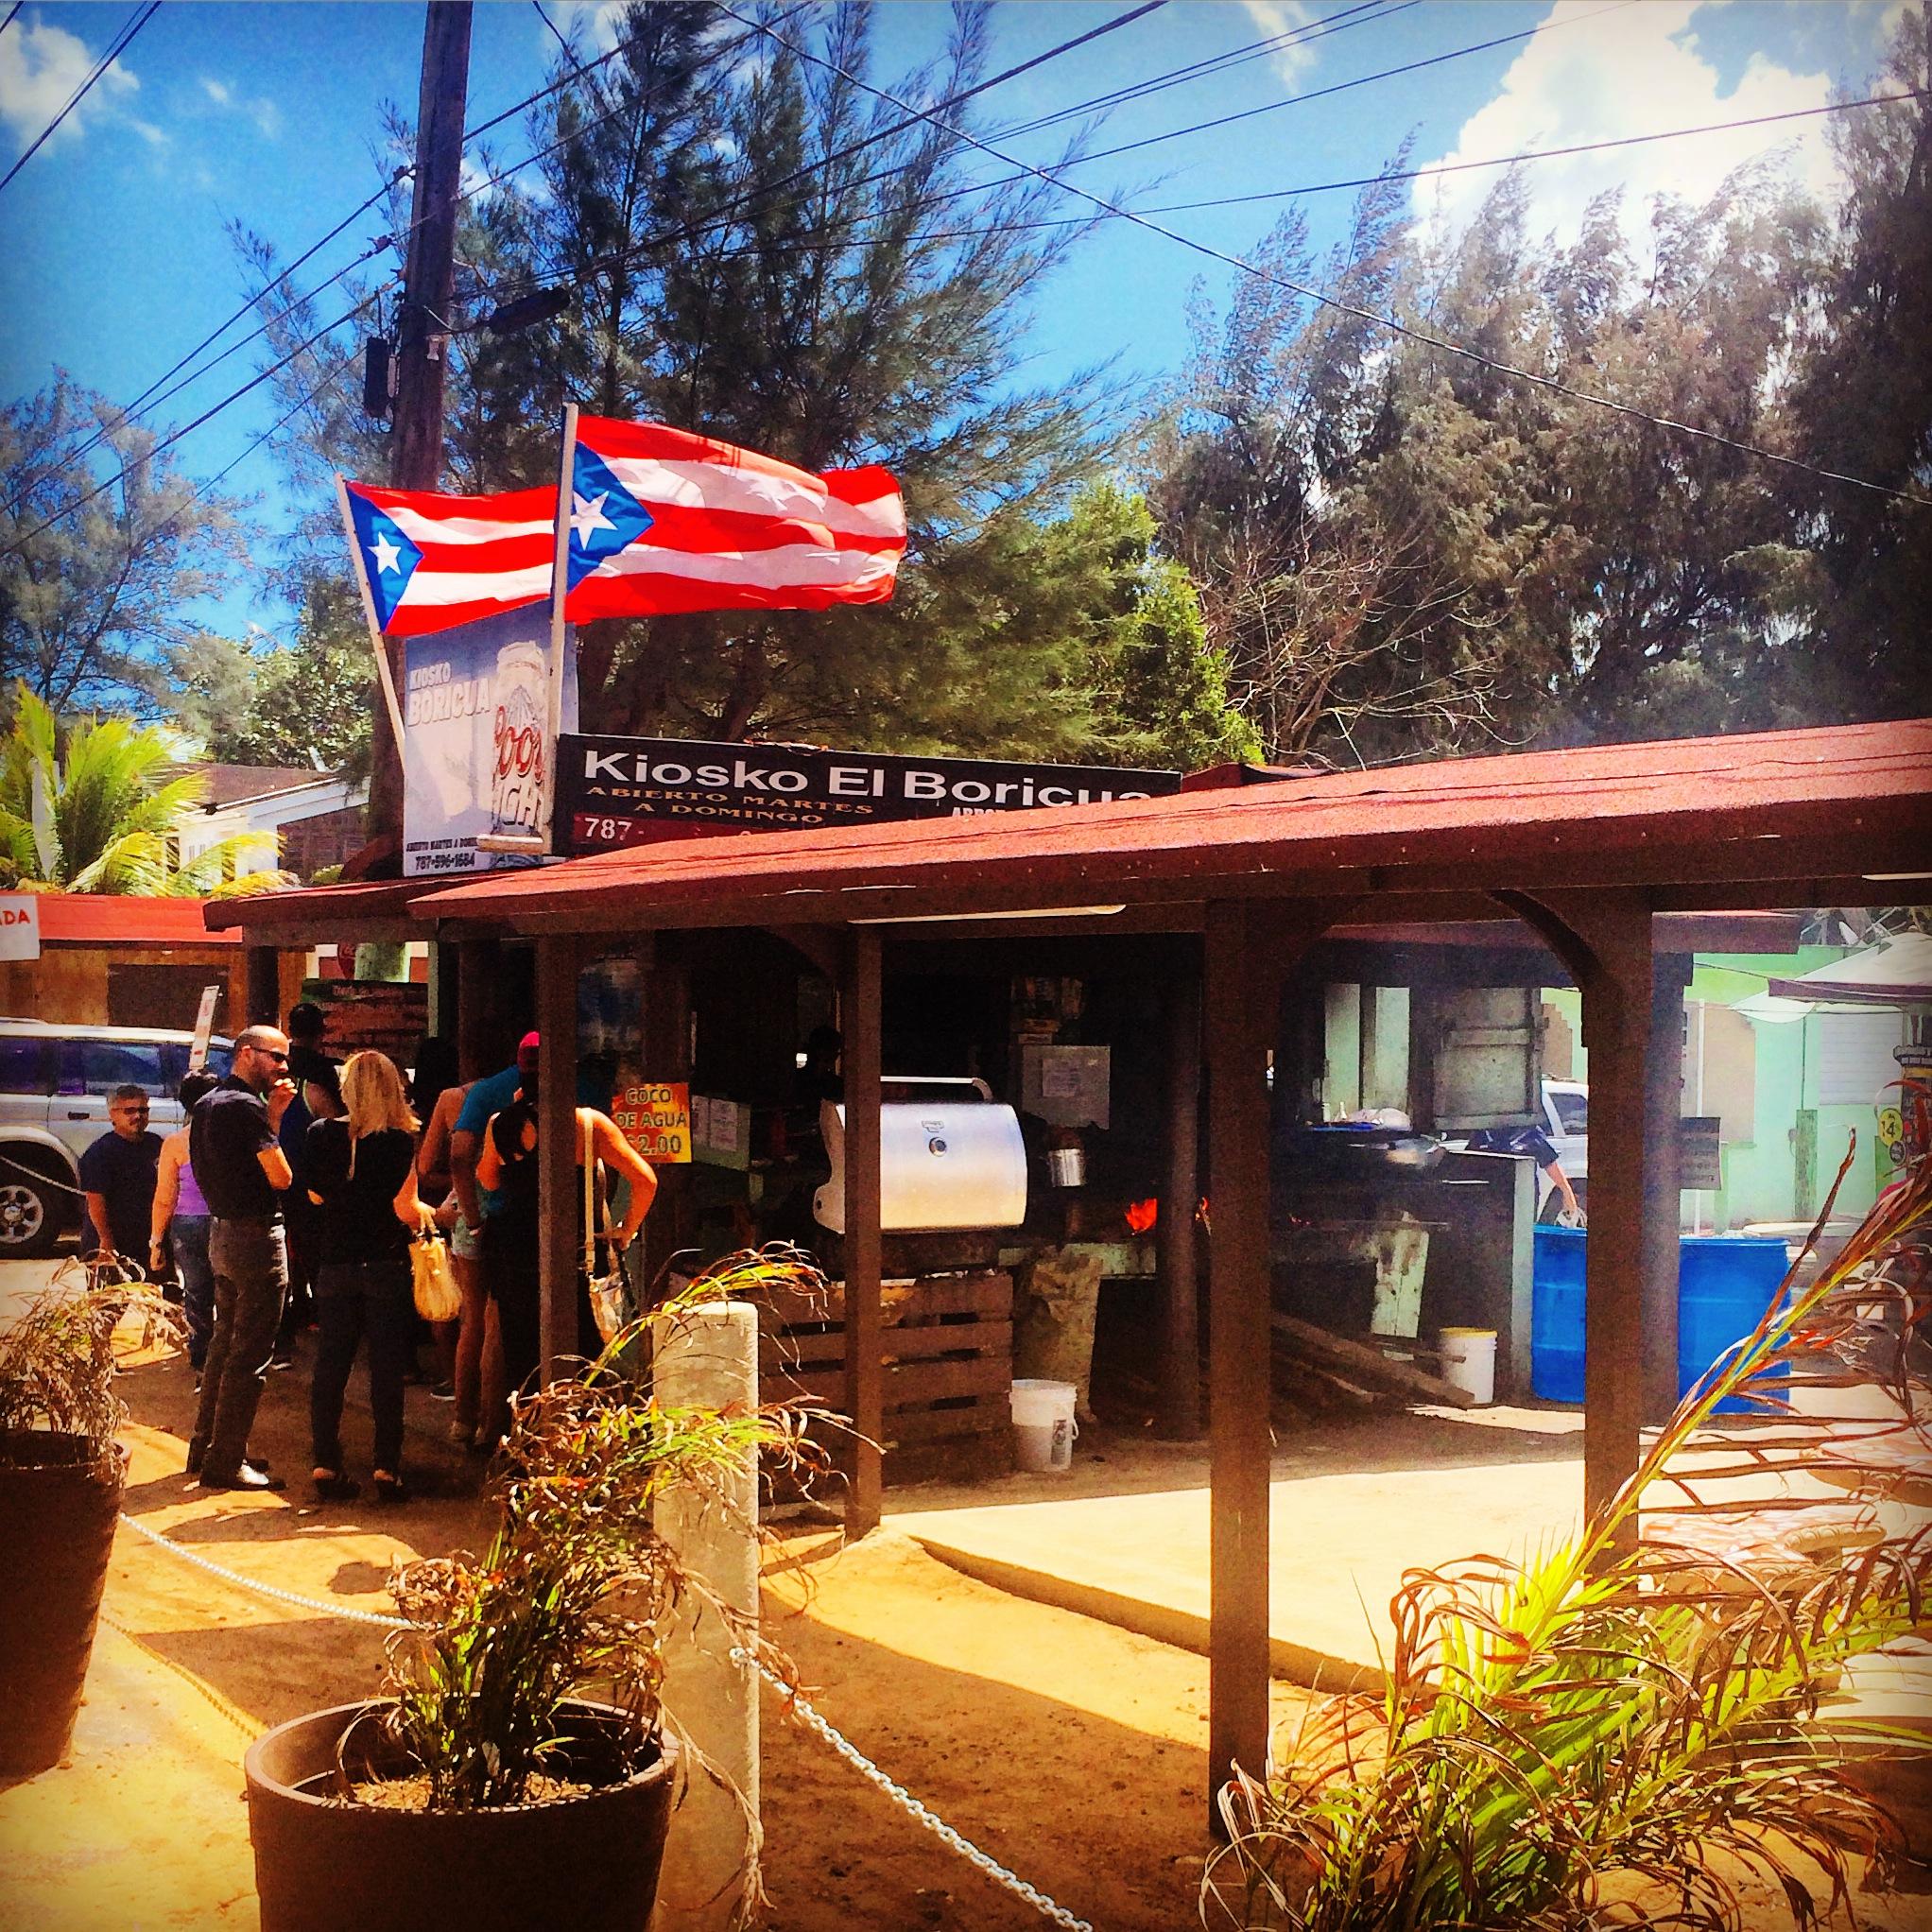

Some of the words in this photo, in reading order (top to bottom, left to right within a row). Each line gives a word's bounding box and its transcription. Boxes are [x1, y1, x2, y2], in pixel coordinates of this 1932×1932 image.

[409, 662, 452, 691] KIOSKO
[408, 679, 491, 727] BORICUA
[583, 750, 808, 792] Kiosko
[828, 767, 885, 797] El
[586, 786, 728, 802] ABIERTO
[743, 796, 874, 815] MARTES
[634, 802, 655, 812] A
[671, 804, 823, 823] DOMINGO
[0, 908, 30, 926] DA
[626, 1088, 672, 1105] COCO
[616, 1112, 638, 1128] DE
[641, 1112, 688, 1128] AGUA
